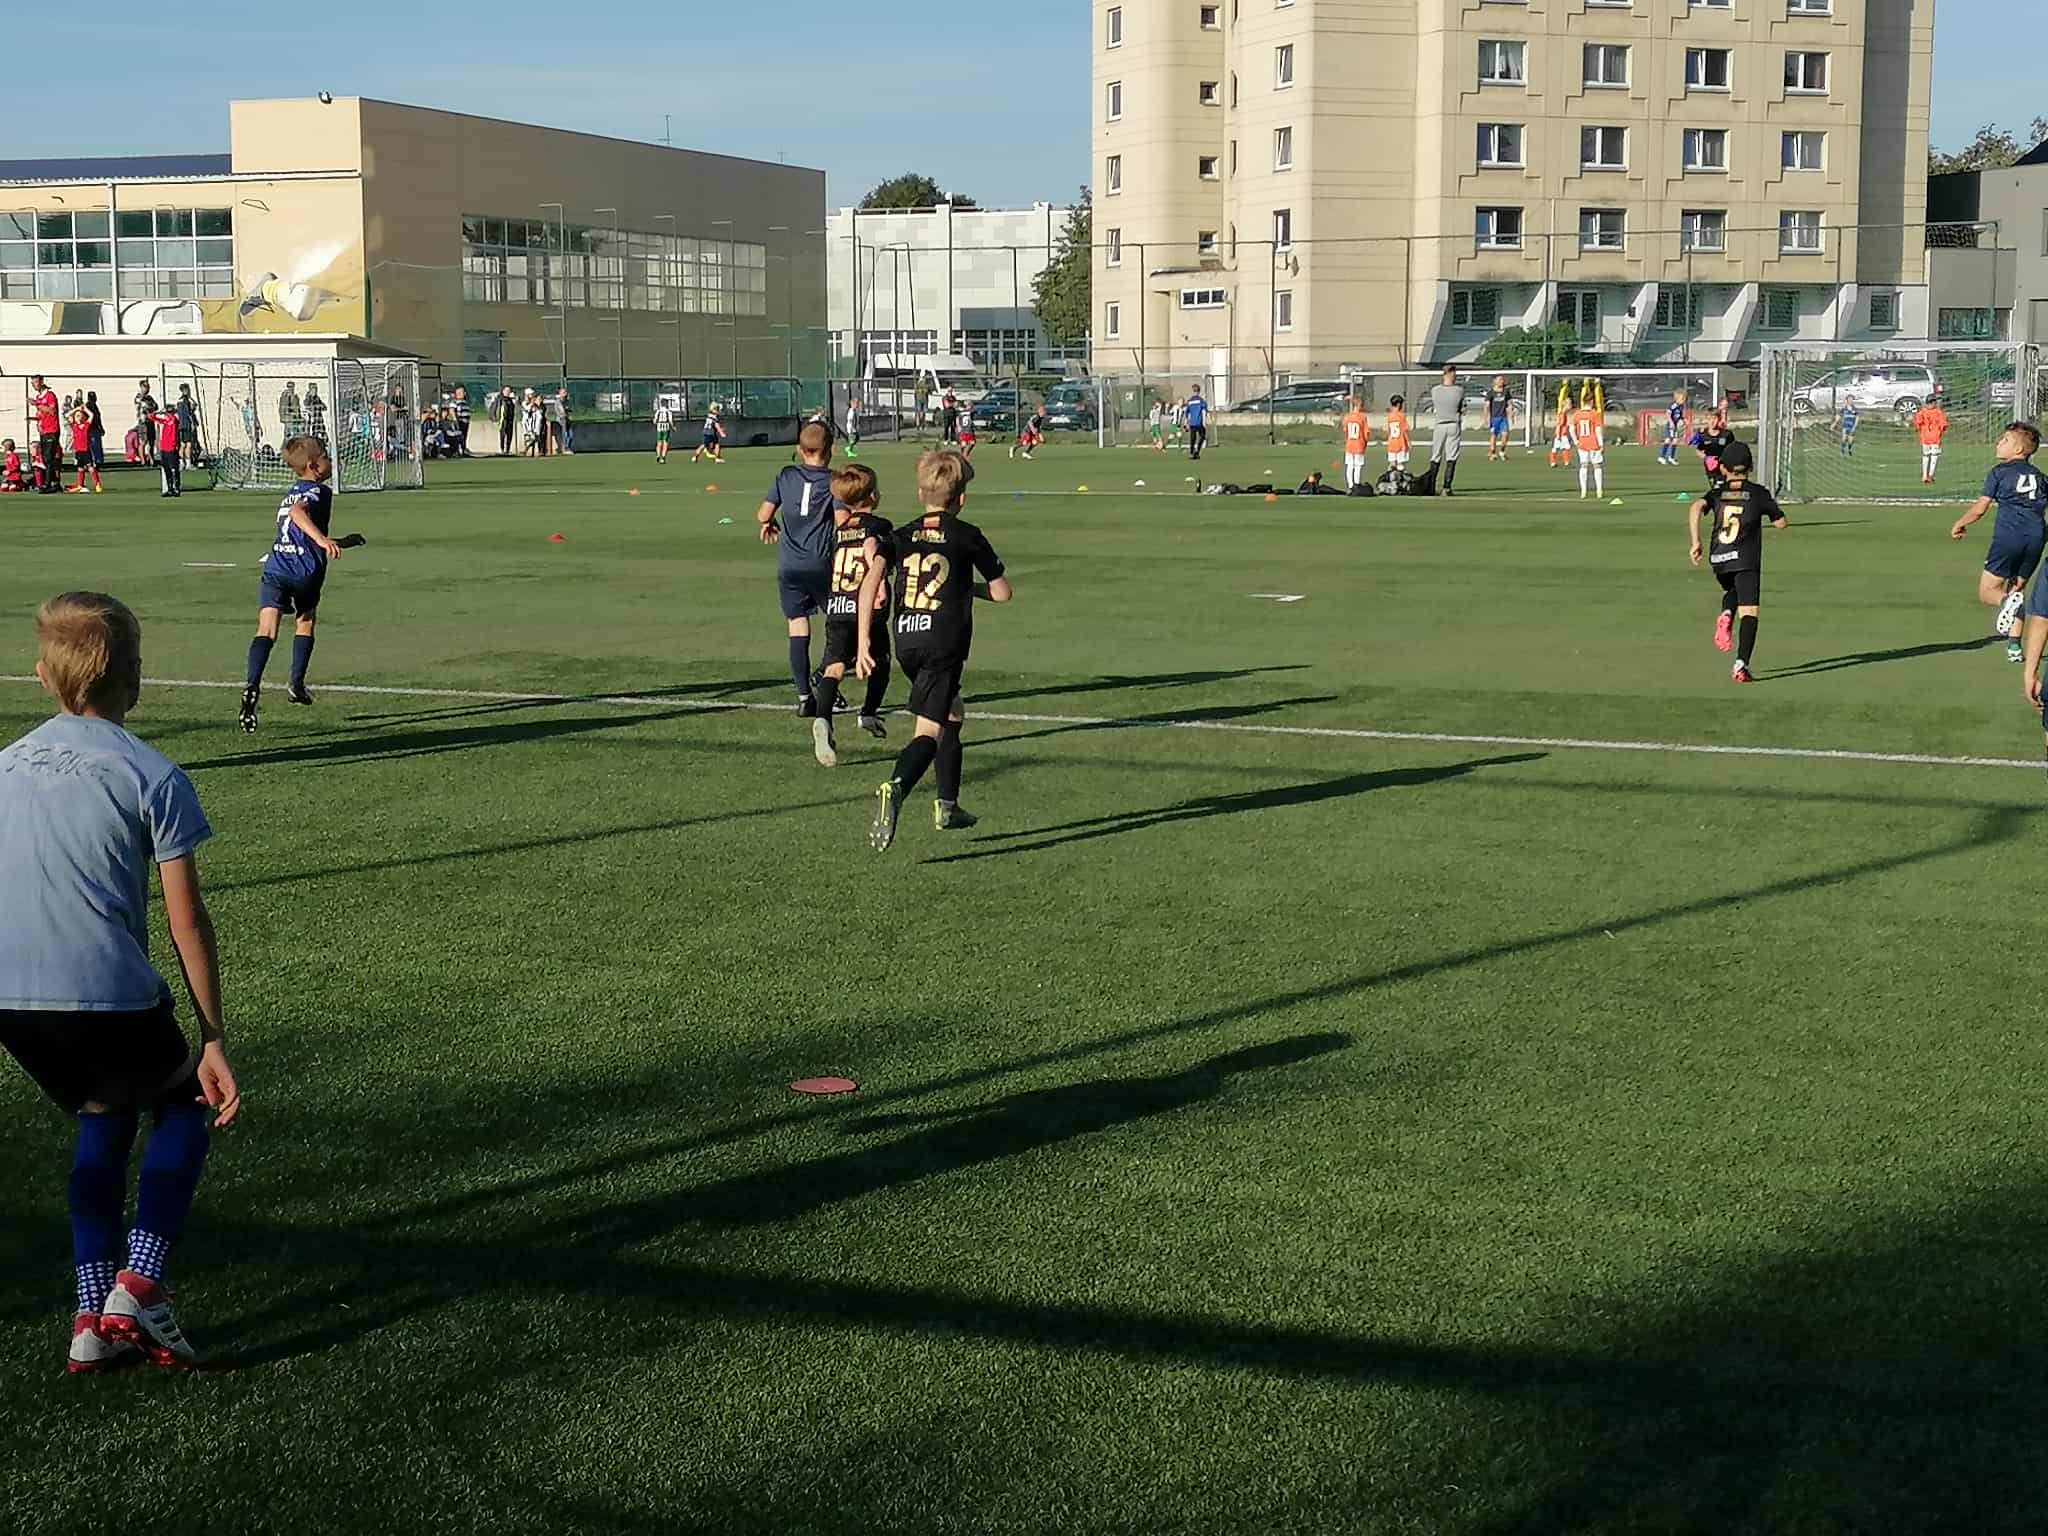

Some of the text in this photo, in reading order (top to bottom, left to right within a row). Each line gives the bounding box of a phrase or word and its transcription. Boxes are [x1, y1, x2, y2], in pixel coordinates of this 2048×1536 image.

[1347, 422, 1360, 439] 10
[800, 482, 813, 517] 1
[2015, 474, 2038, 500] 4
[1718, 505, 1745, 545] 5
[831, 546, 866, 593] 15
[902, 552, 950, 611] 12
[898, 613, 932, 633] Hila
